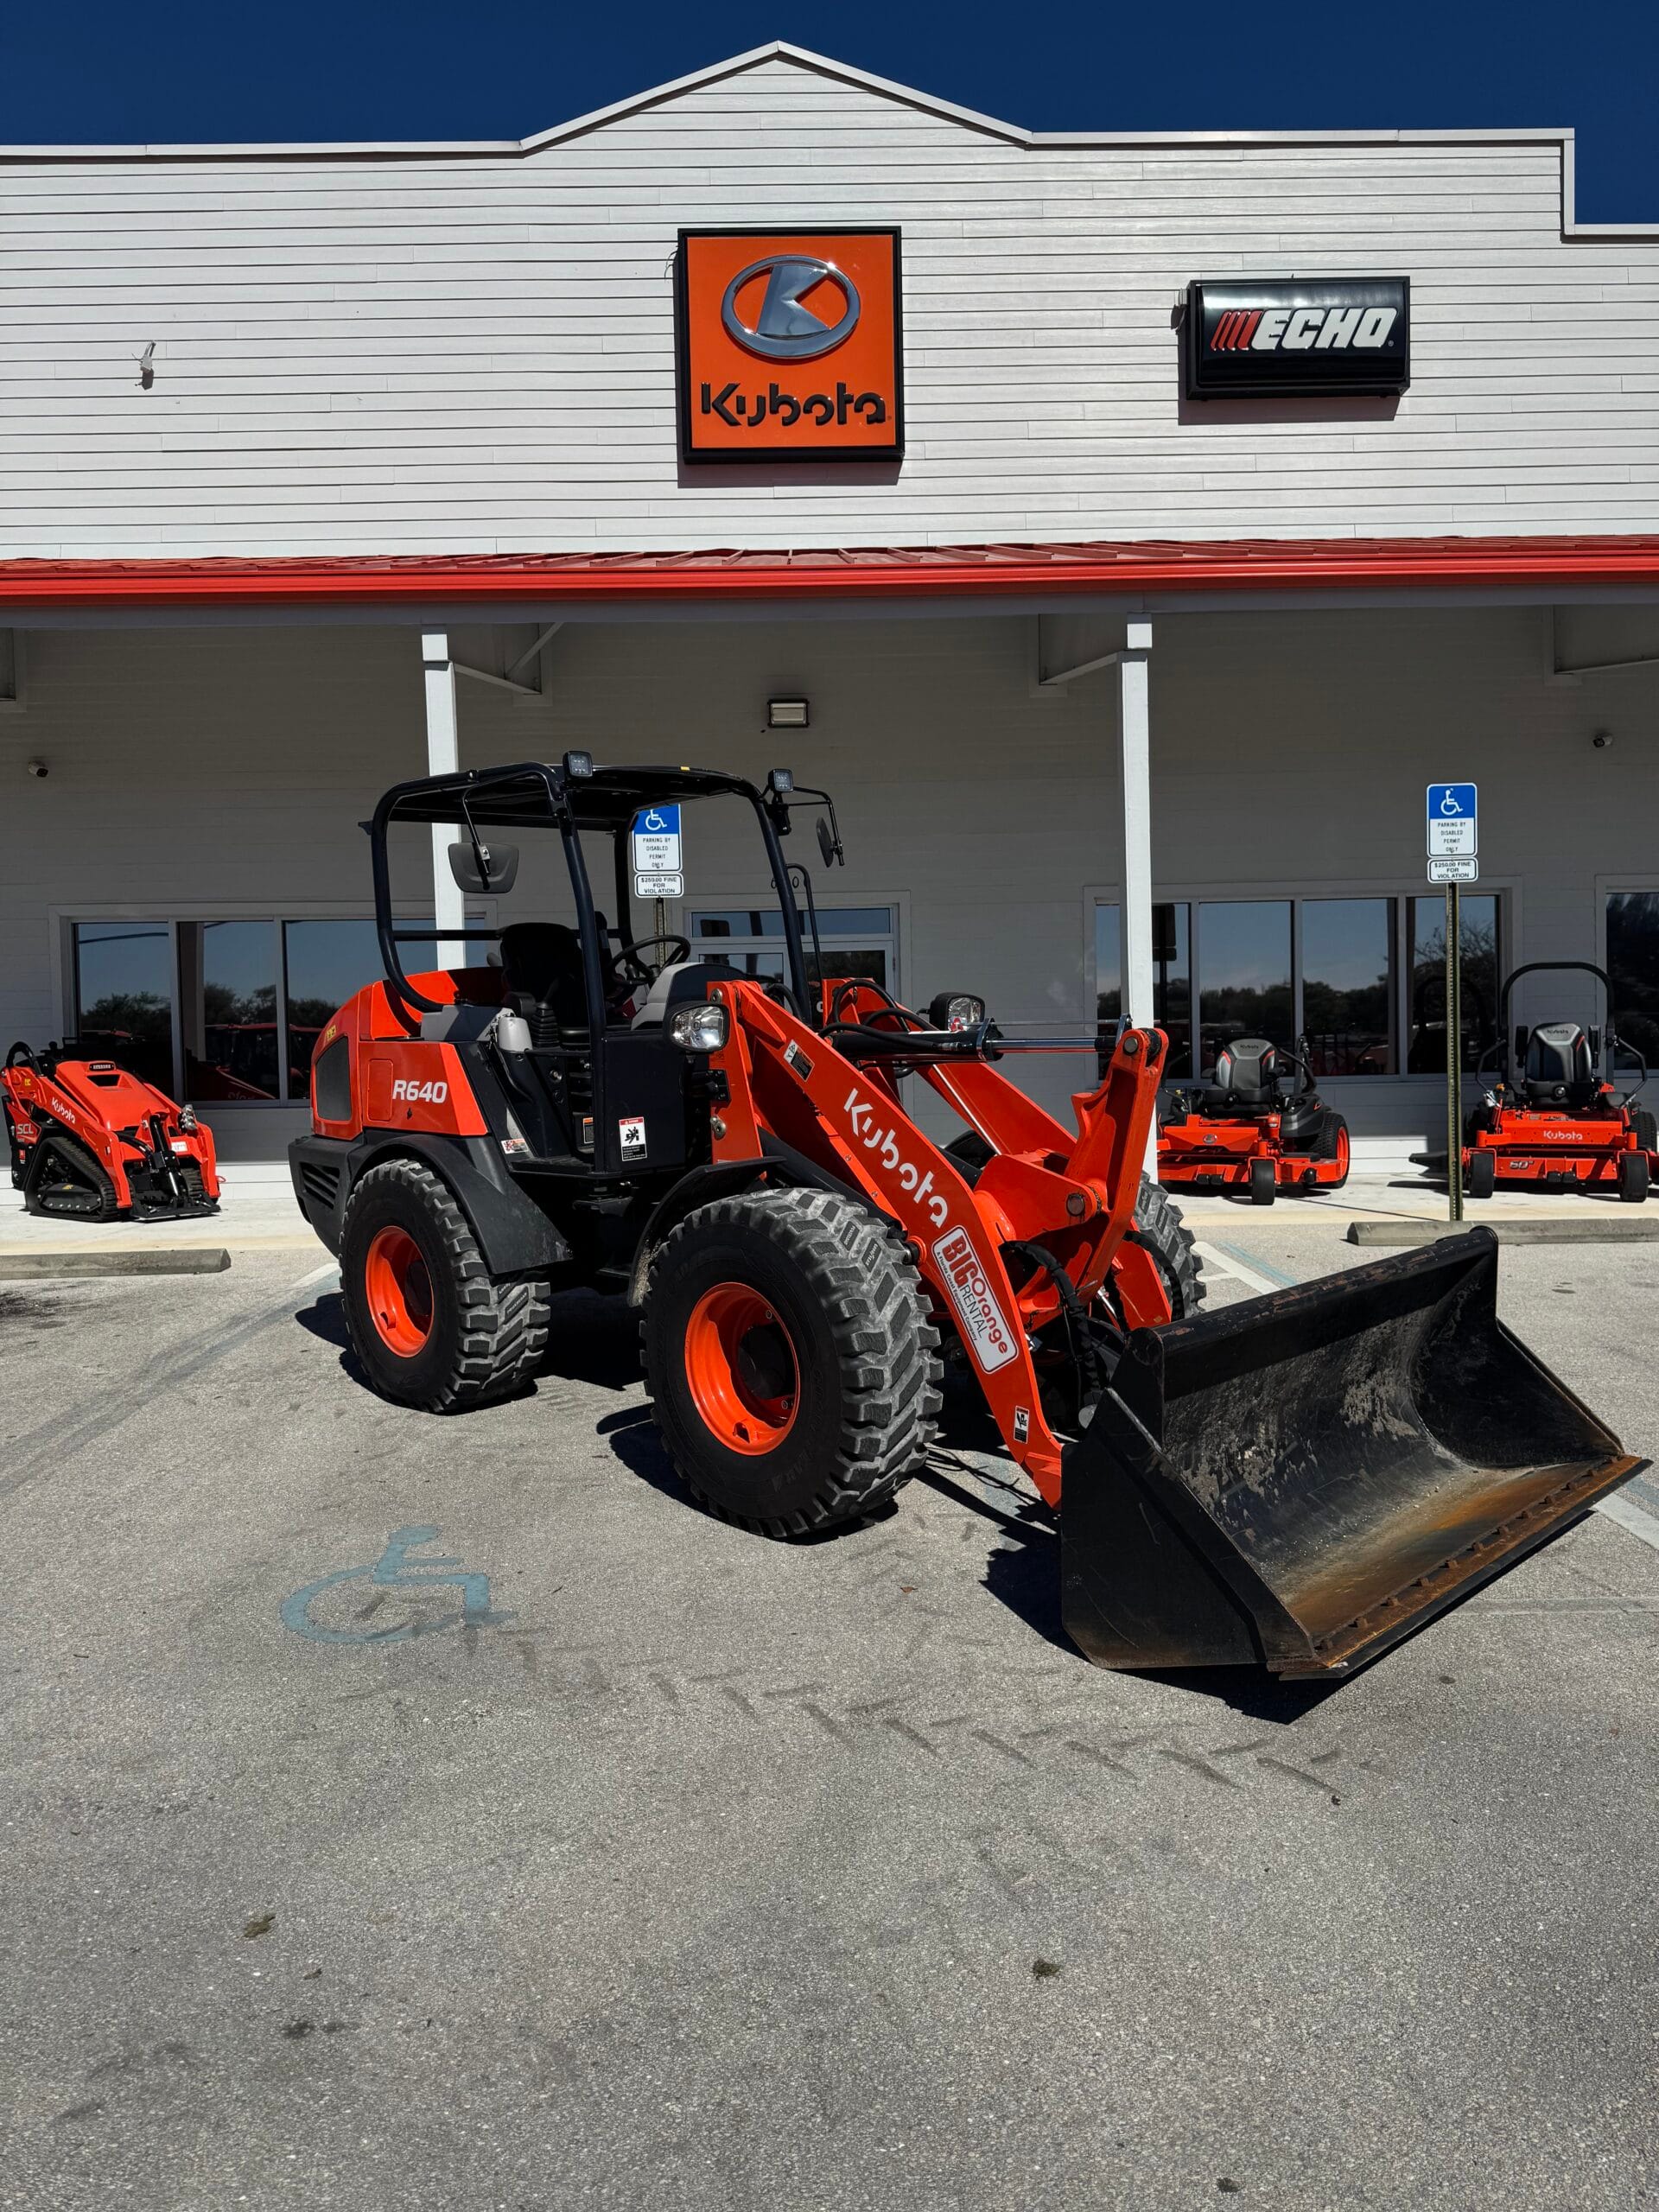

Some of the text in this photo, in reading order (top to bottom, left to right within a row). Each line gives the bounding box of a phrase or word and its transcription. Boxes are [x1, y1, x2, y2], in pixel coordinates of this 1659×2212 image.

[1251, 307, 1398, 350] ECHO
[701, 382, 886, 426] Kubota
[52, 1096, 76, 1124] Kubota
[392, 1080, 448, 1103] R640
[17, 1123, 34, 1135] SCL
[1543, 1130, 1583, 1141] Kubota
[843, 1088, 948, 1229] Kubota
[938, 1255, 949, 1274] Florida
[946, 1274, 956, 1288] Coast
[952, 1288, 969, 1316] Equipment
[964, 1316, 978, 1341] Company
[942, 1235, 1008, 1354] BIG Orange
[959, 1285, 988, 1338] RENTAL
